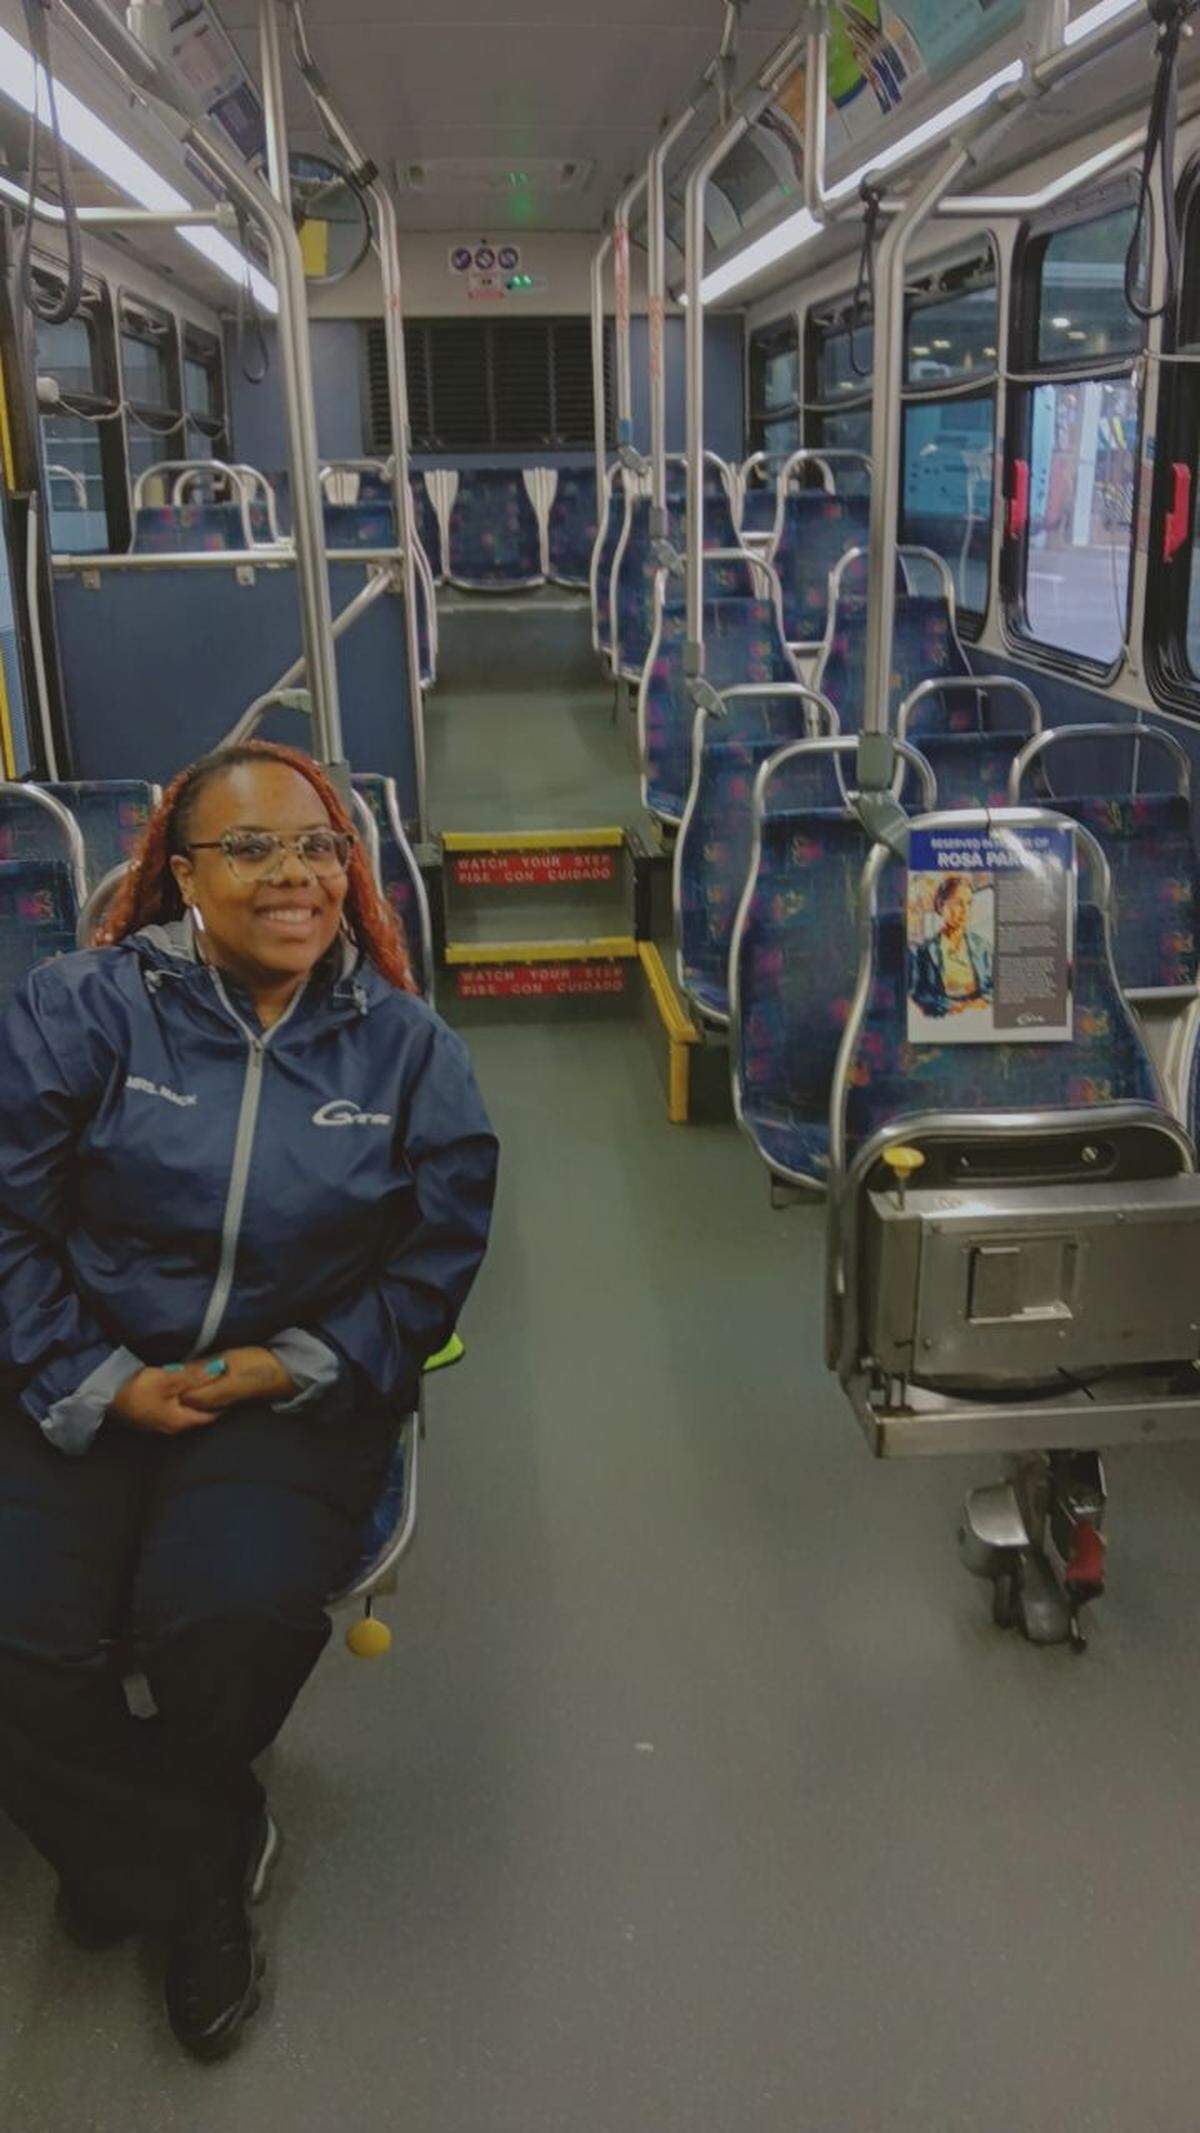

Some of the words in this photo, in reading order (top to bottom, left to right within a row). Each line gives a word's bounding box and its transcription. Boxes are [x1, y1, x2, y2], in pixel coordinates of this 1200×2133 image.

[457, 857, 508, 870] WATCH
[521, 856, 560, 869] YOUR
[574, 855, 611, 867] STEP
[938, 852, 983, 868] ROSA
[458, 871, 491, 883] PISE
[505, 870, 534, 882] CON
[547, 868, 611, 881] CUIDADO
[460, 970, 515, 982] WATCH
[529, 968, 570, 981] YOUR
[585, 967, 623, 979] STEP
[462, 984, 496, 996] PISE
[511, 983, 542, 994] CON
[558, 981, 623, 993] CUIDADO
